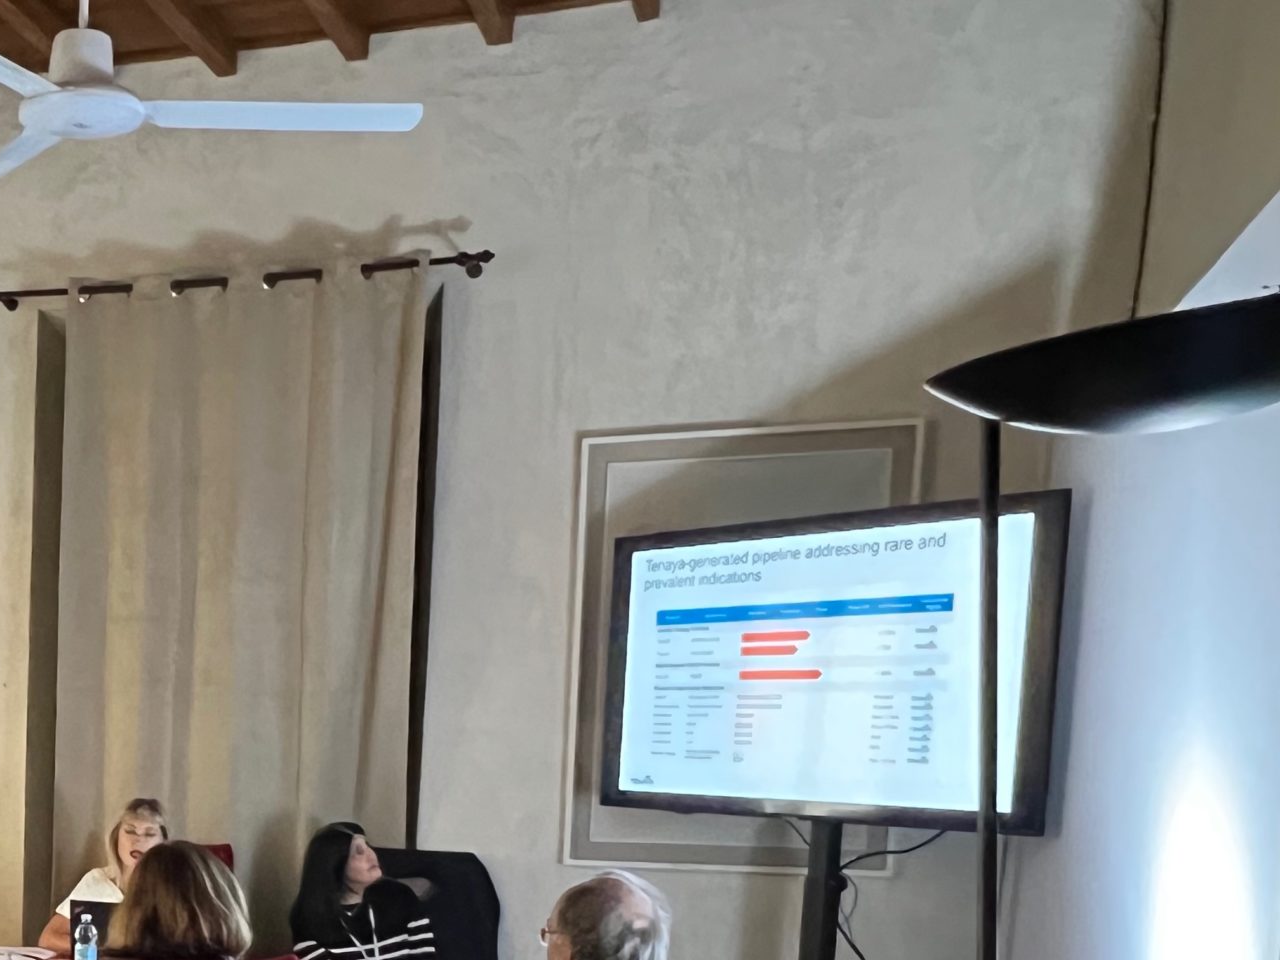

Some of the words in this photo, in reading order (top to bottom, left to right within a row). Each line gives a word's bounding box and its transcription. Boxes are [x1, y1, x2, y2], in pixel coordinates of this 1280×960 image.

[752, 549, 801, 565] pipeline
[805, 541, 880, 559] addressing
[885, 539, 914, 552] rare
[918, 533, 947, 549] and
[644, 574, 696, 592] prevalent
[698, 571, 763, 586] indications
